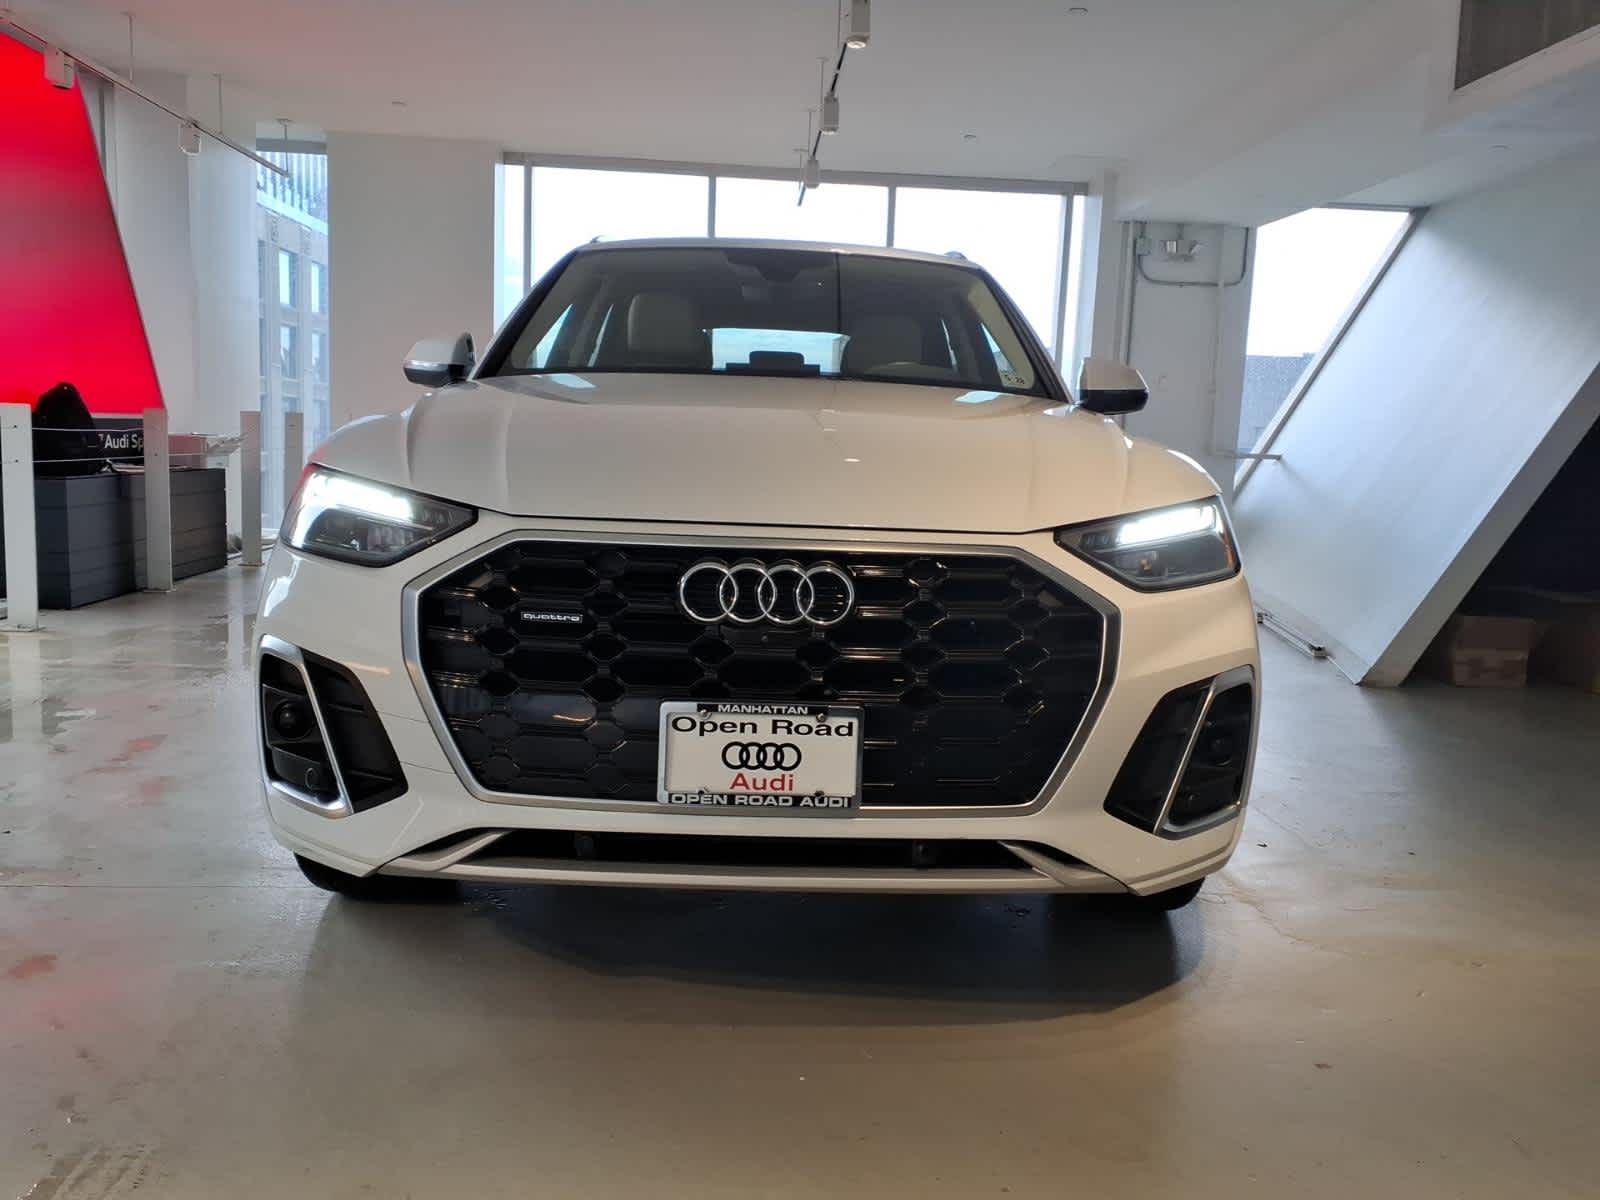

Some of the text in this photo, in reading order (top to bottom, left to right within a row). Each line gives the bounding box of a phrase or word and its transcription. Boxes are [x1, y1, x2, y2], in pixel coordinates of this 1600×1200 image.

[104, 433, 129, 449] Audi
[523, 613, 580, 622] quattro
[717, 704, 808, 715] MANHATTAN
[671, 716, 853, 737] Open Road
[729, 772, 794, 791] Audi
[671, 793, 849, 808] OPEN ROAD AUDI
